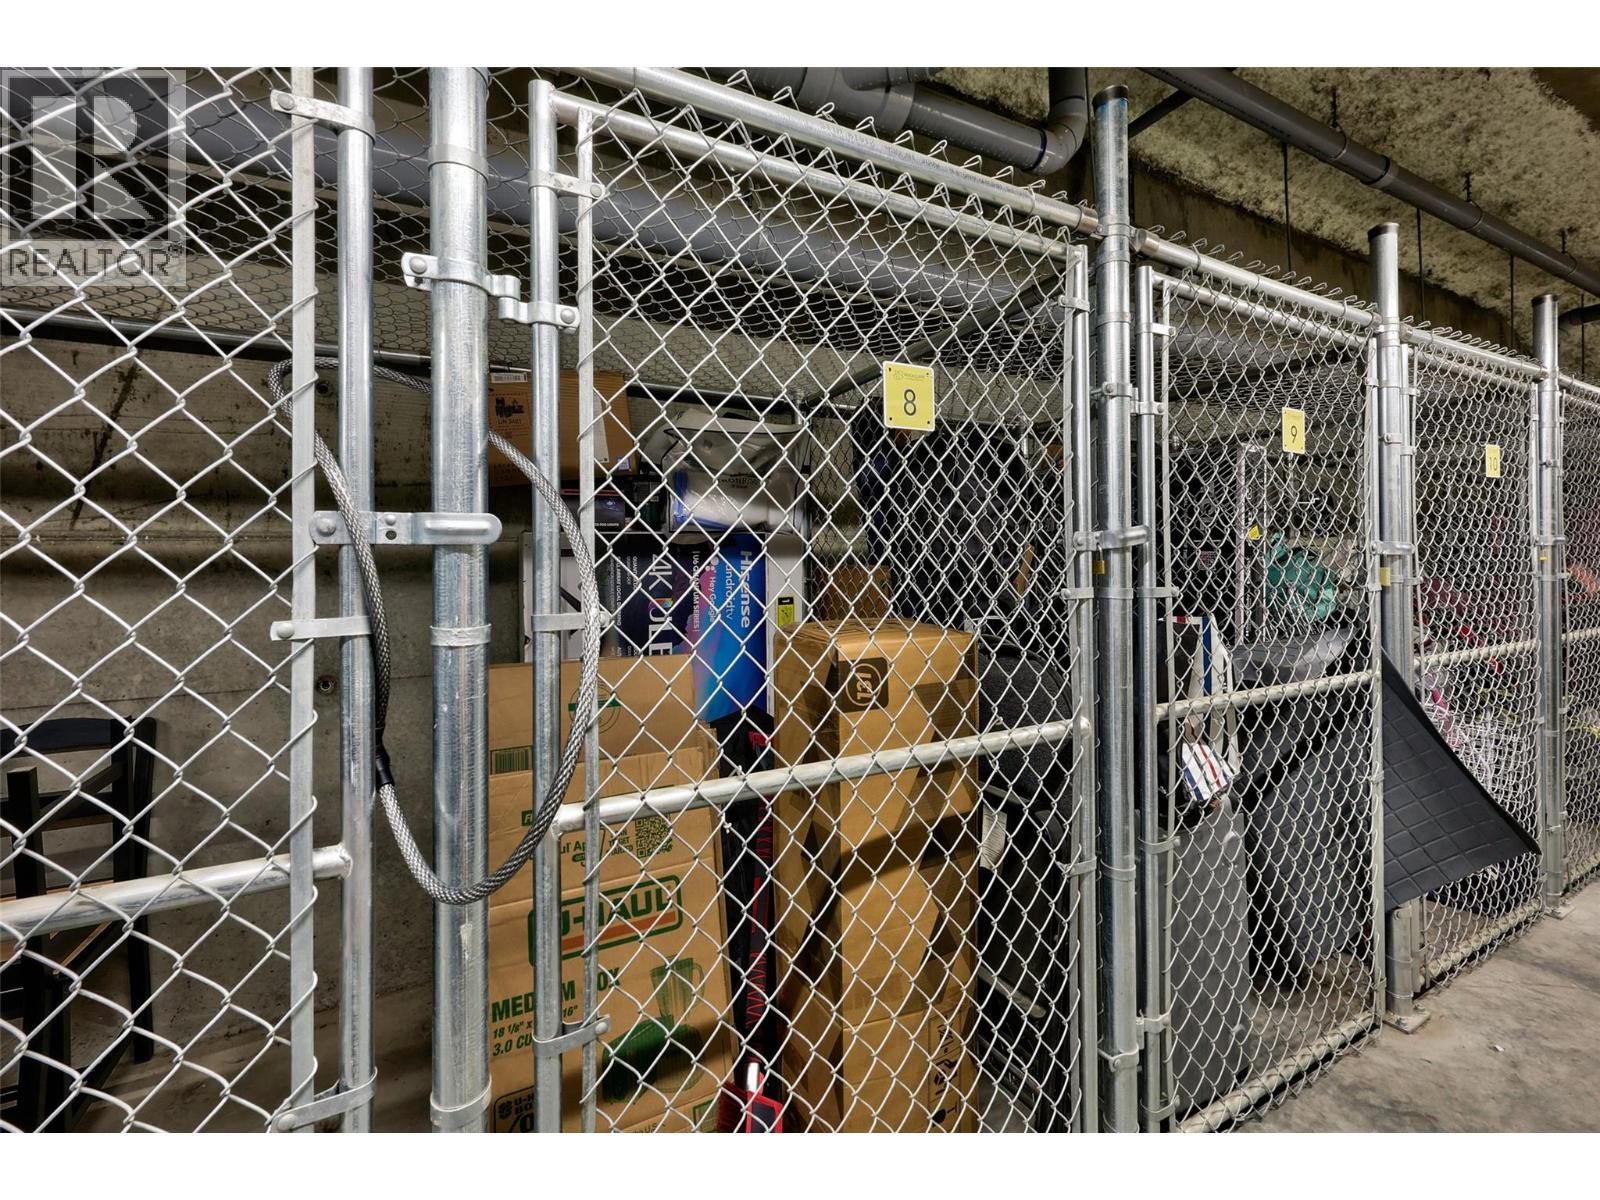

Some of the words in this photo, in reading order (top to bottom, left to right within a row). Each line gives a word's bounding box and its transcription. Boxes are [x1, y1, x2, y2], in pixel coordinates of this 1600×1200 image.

[903, 388, 917, 416] 8
[1290, 425, 1298, 443] 9
[1489, 456, 1498, 471] 10
[649, 554, 673, 591] 4K
[708, 576, 717, 592] Hey
[741, 551, 753, 629] Hisense
[692, 603, 700, 629] SERIES
[708, 594, 717, 623] Google
[649, 598, 673, 656] ULE
[492, 981, 576, 1022] MEDM
[597, 967, 621, 992] OX
[494, 1027, 505, 1039] 18
[493, 1039, 513, 1056] 3.0
